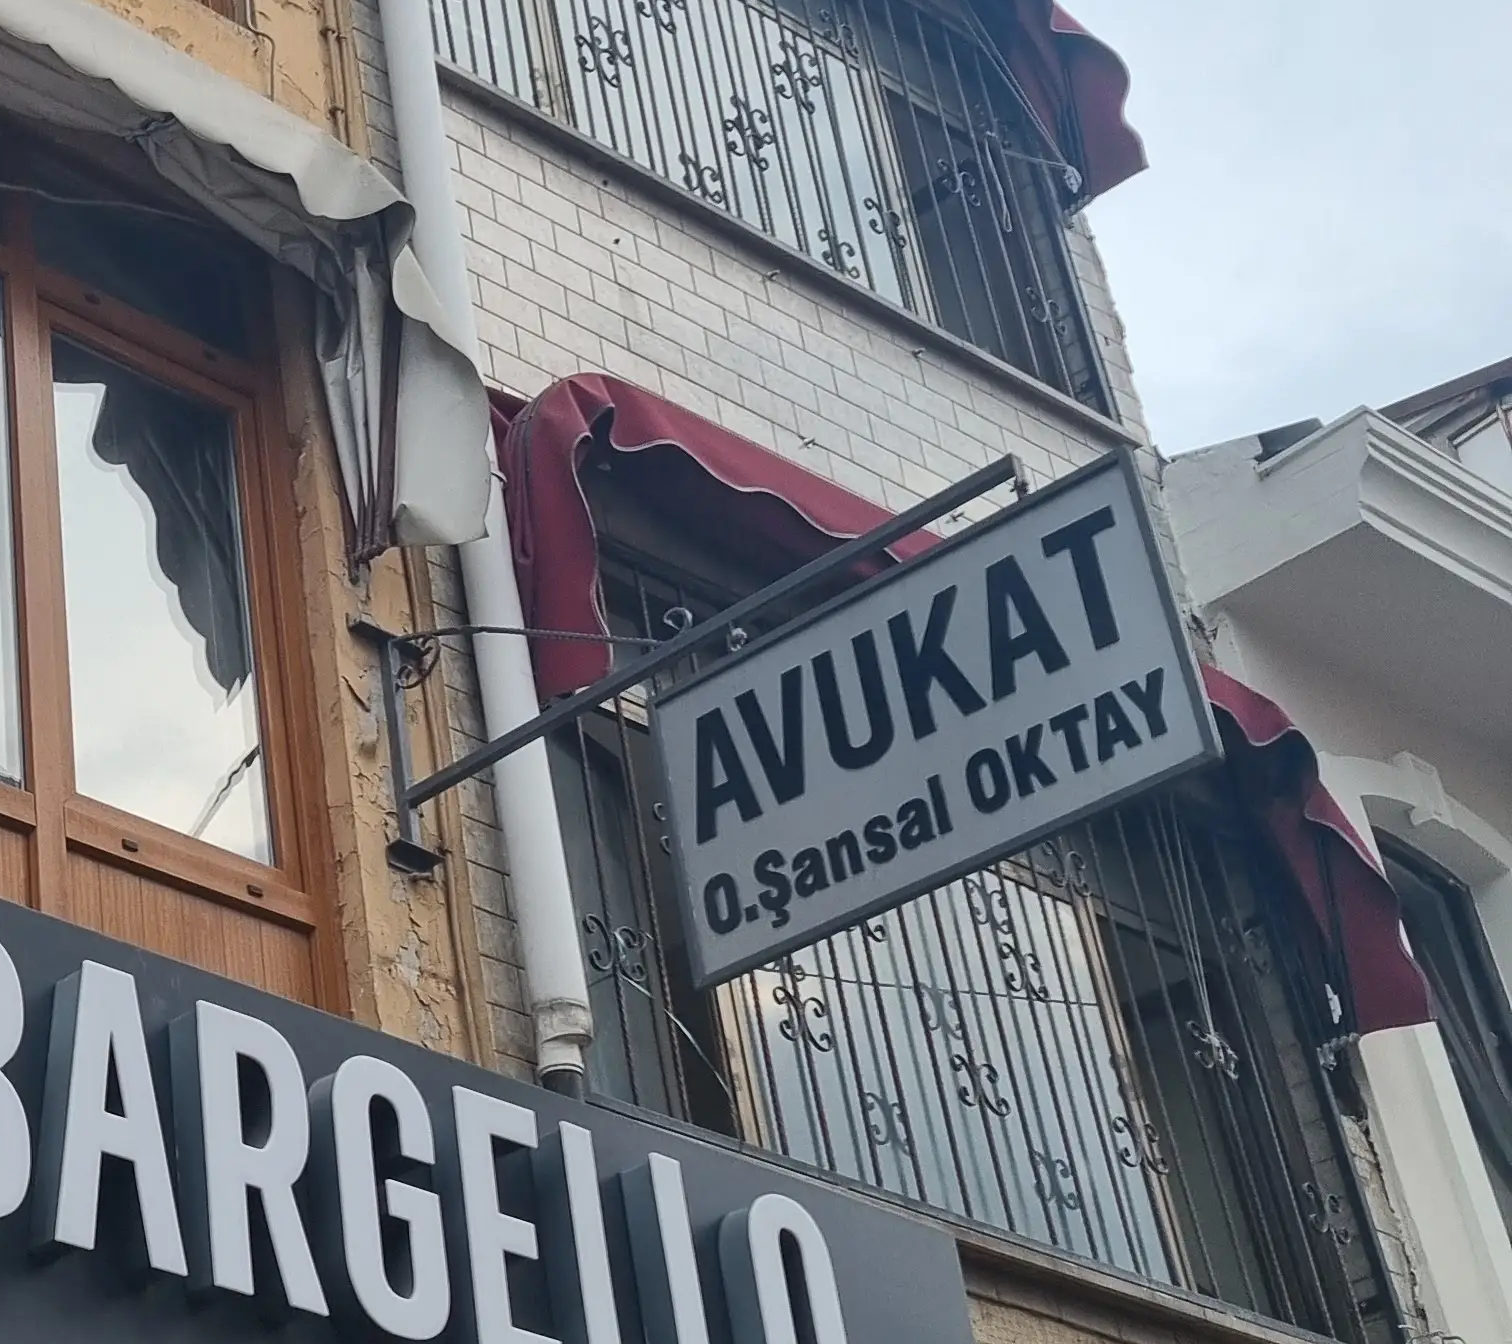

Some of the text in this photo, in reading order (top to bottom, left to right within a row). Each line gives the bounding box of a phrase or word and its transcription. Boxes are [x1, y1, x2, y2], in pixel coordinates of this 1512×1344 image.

[695, 504, 1121, 846] AVUKAT
[702, 666, 1167, 936] O.Şansal OKTAY
